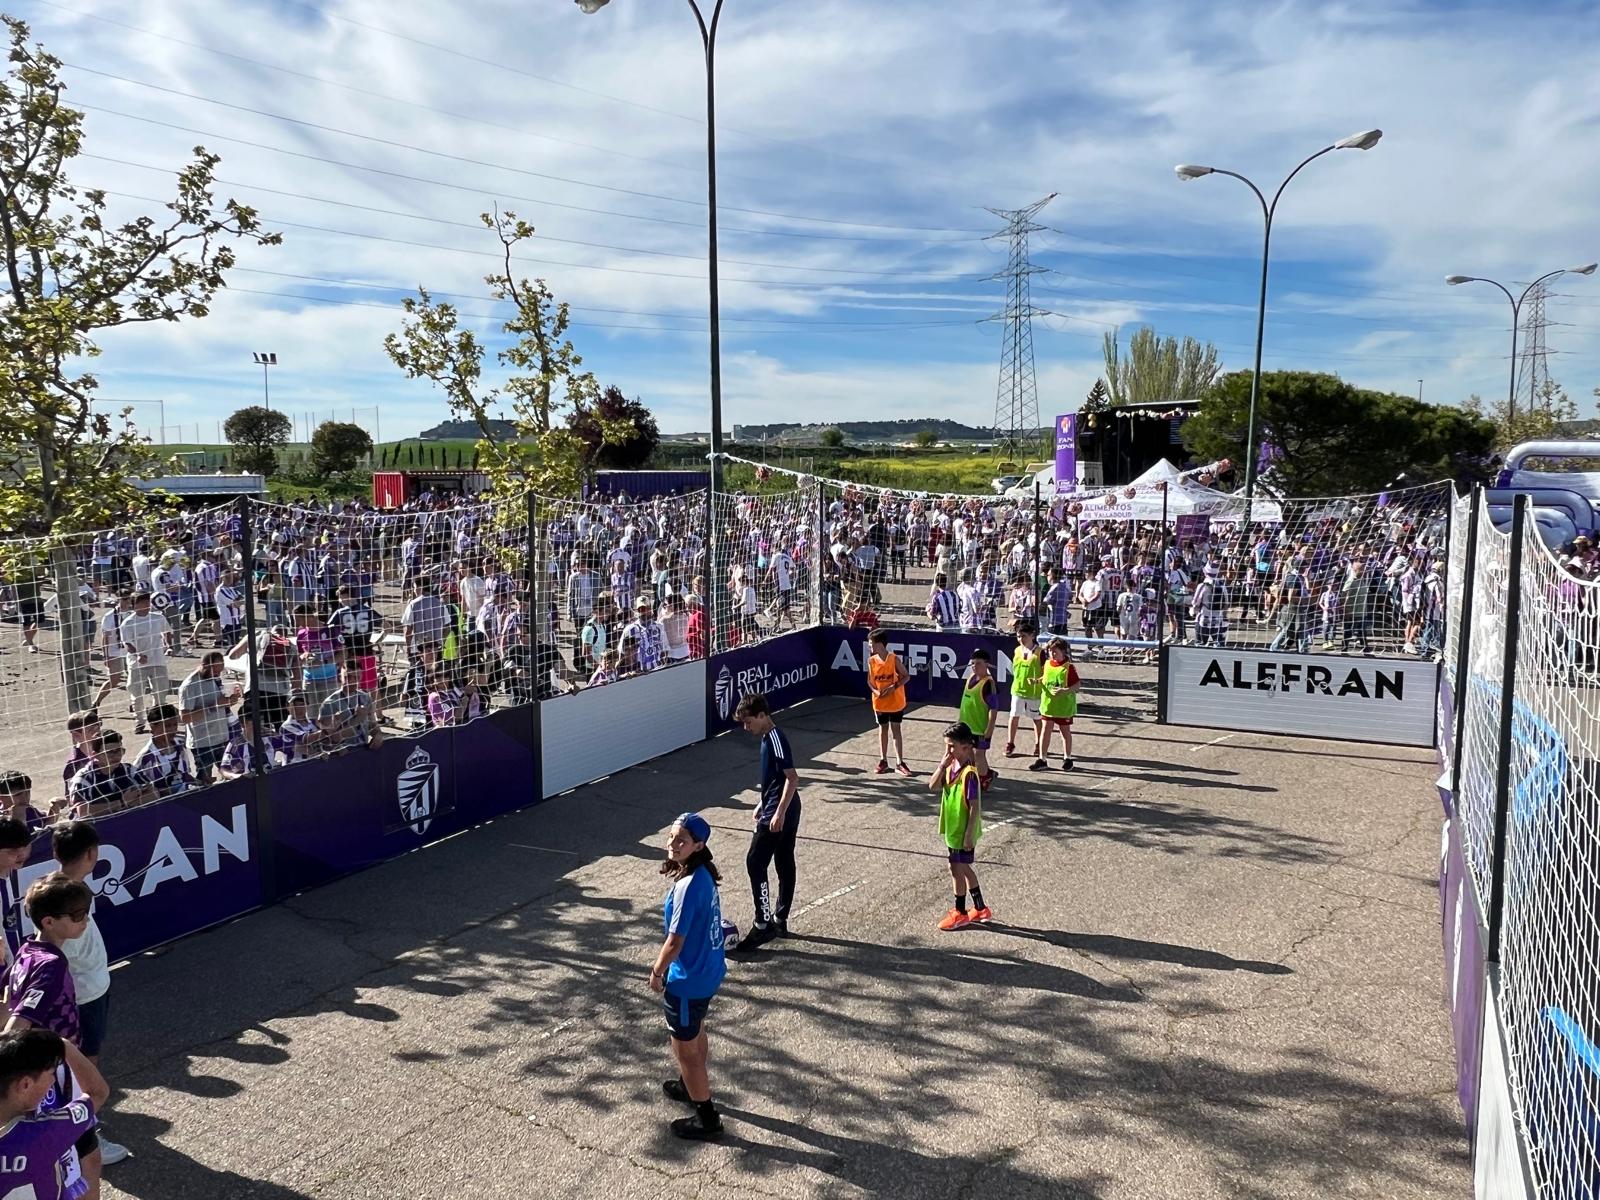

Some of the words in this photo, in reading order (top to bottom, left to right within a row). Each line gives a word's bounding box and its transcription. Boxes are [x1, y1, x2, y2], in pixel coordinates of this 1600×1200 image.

[1048, 476, 1096, 486] ARAN
[1084, 503, 1132, 512] ALIMENTOS
[737, 663, 772, 688] REAL
[737, 663, 819, 702] VALLADOLID
[1199, 658, 1404, 701] ALEFRAN
[760, 881, 771, 922] adidas
